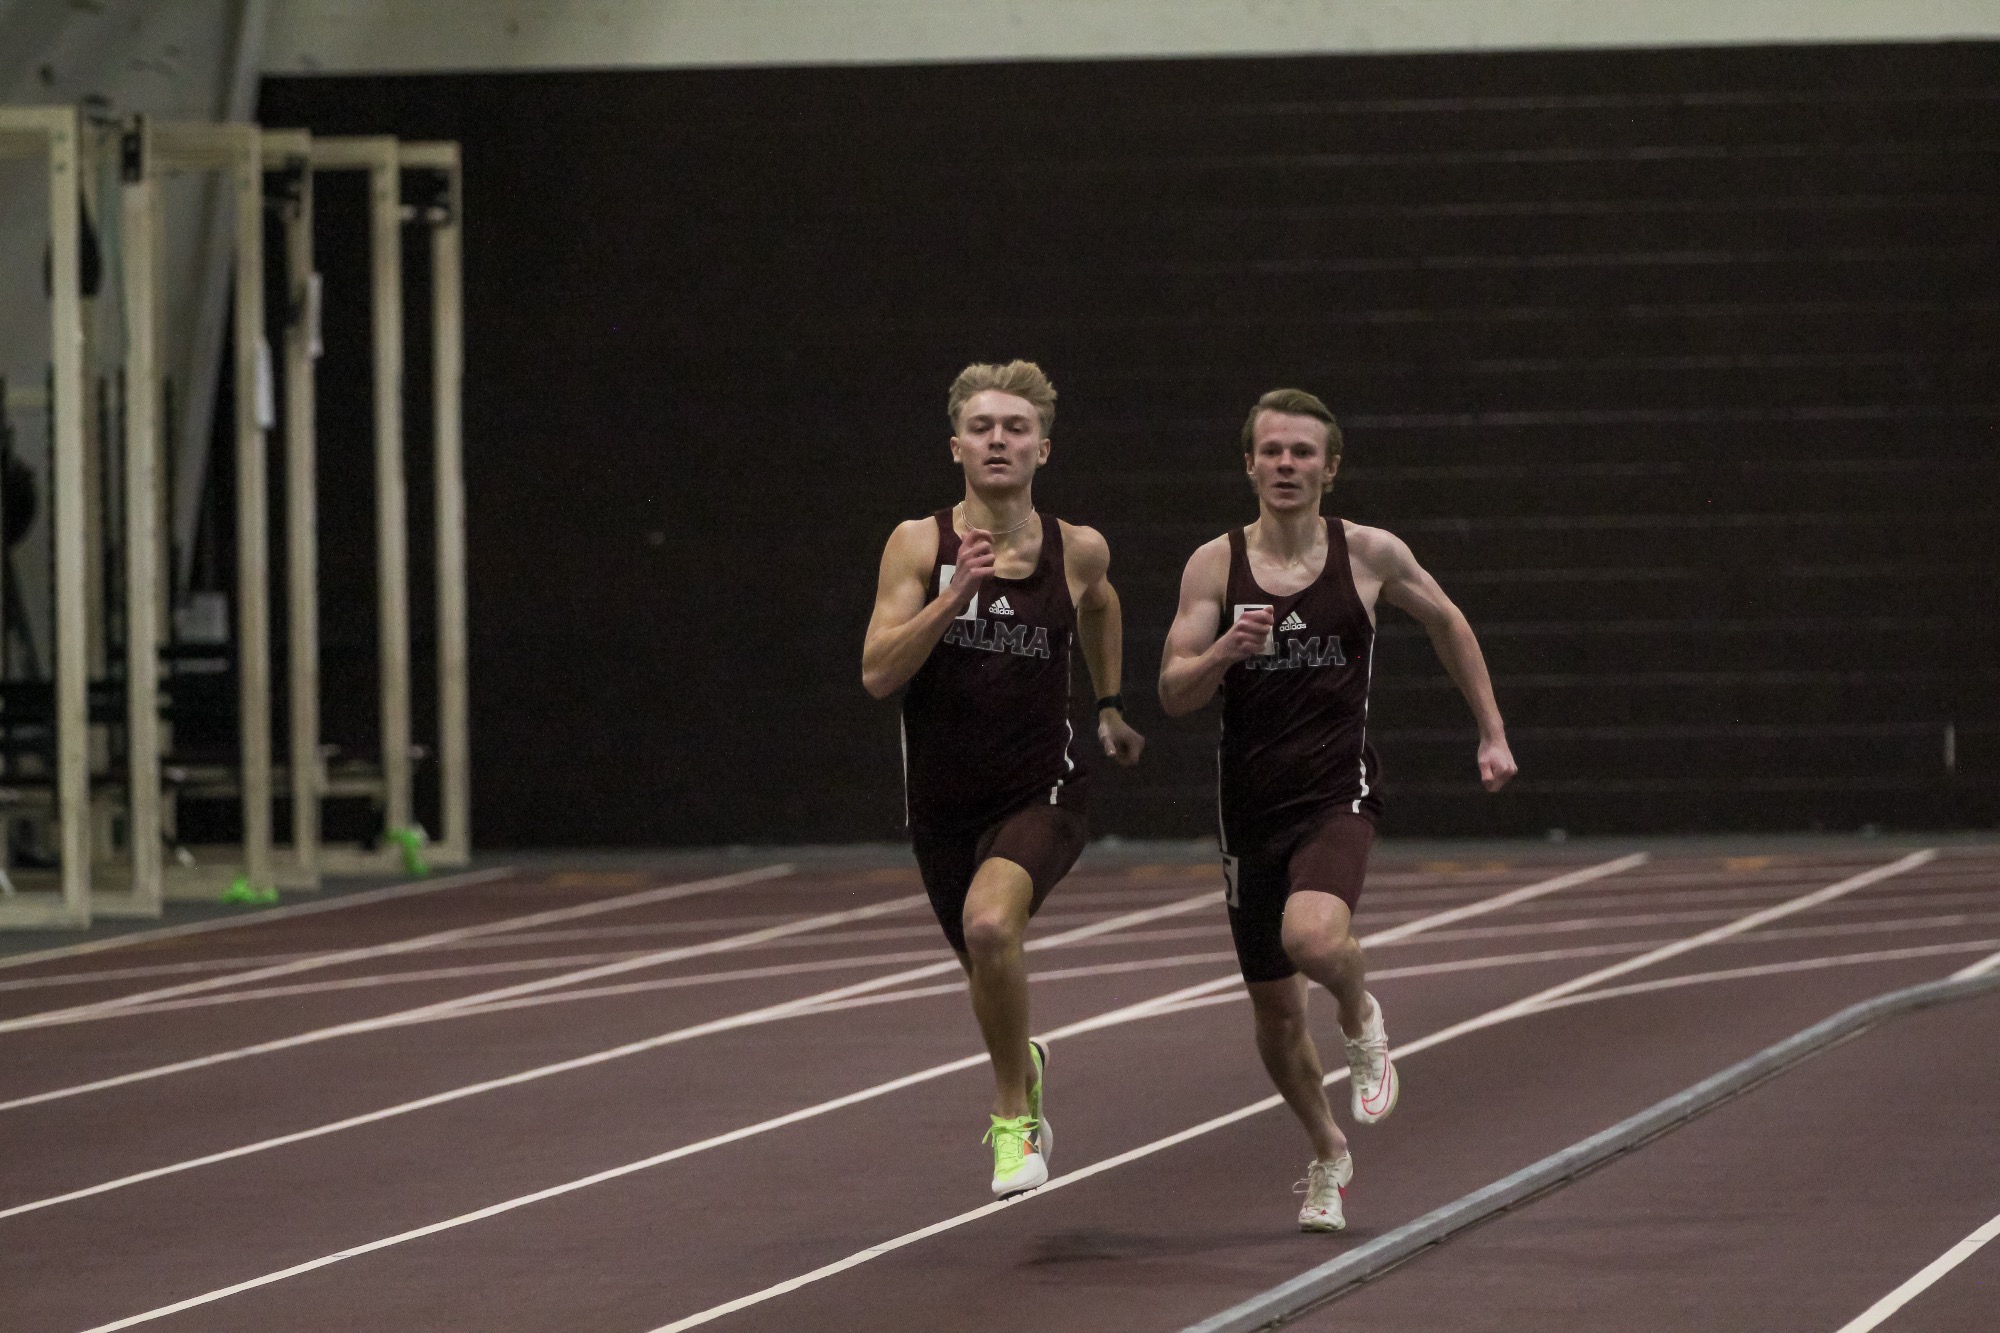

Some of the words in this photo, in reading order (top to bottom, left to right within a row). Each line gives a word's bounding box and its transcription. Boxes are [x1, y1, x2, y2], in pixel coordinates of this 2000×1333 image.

[988, 606, 1015, 616] adidas
[1279, 622, 1307, 632] adidas
[943, 618, 1051, 659] ALMA
